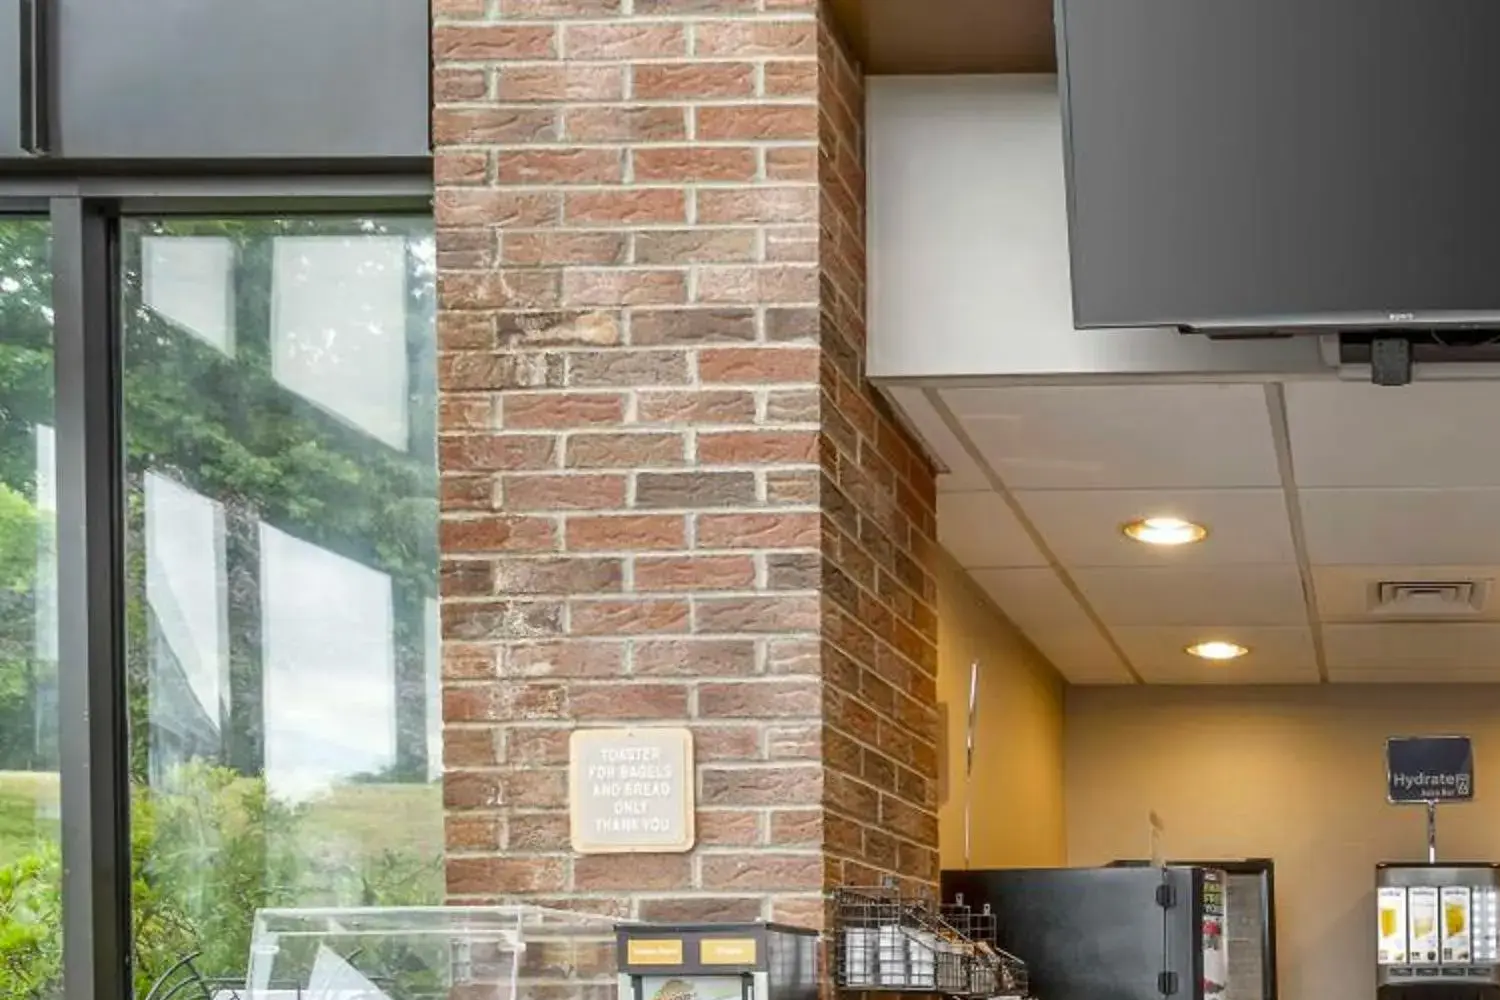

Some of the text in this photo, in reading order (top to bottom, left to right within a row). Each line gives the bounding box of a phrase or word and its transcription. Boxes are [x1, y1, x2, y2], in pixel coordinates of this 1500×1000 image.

[600, 748, 661, 761] TOASTER
[589, 764, 673, 779] FOR BAGELS
[1393, 771, 1455, 790] Hydrate
[593, 781, 671, 797] AND BREAD
[613, 801, 648, 815] ONLY
[596, 816, 671, 833] THANK YOU
